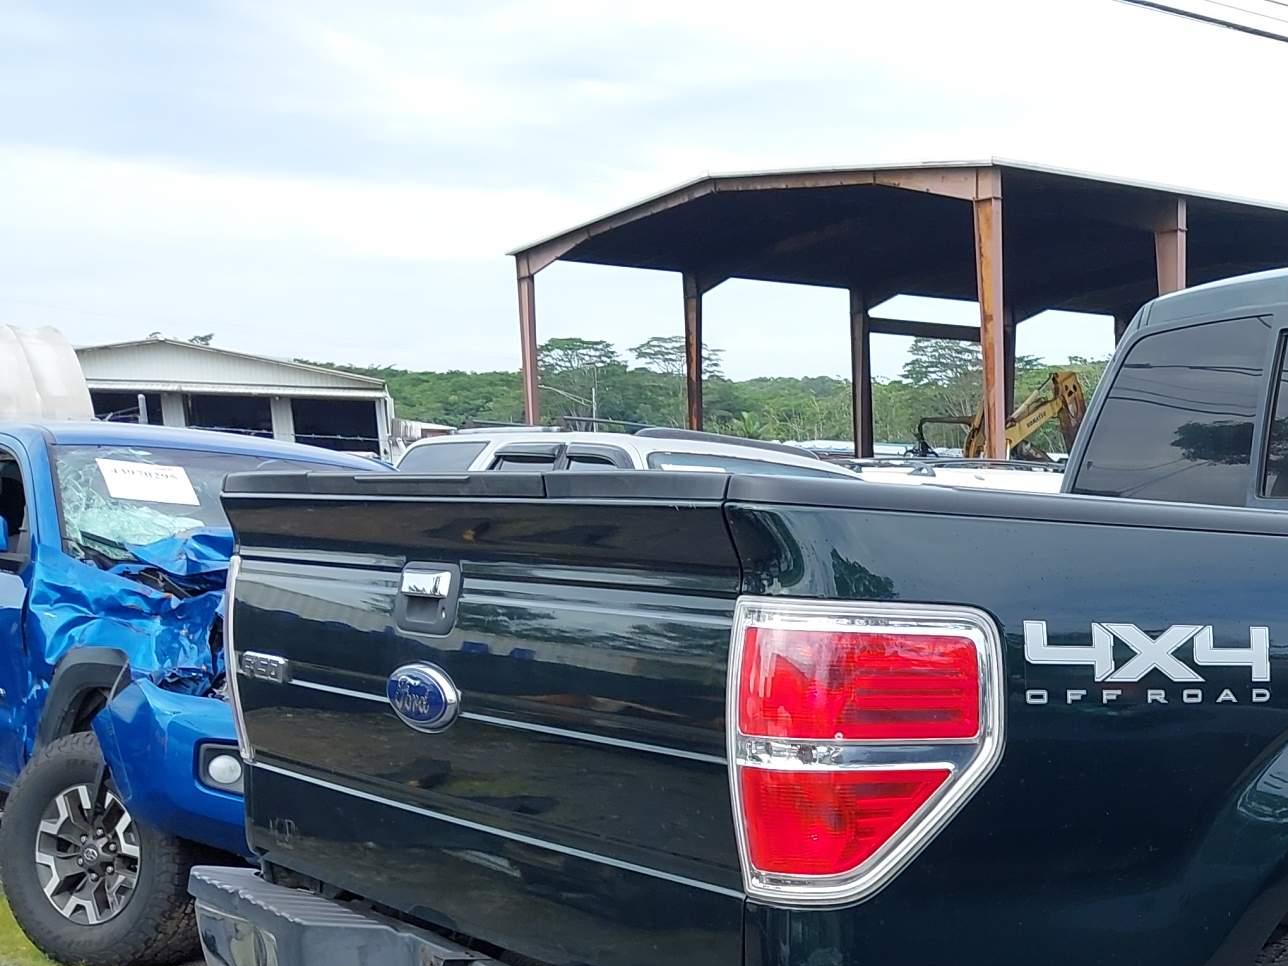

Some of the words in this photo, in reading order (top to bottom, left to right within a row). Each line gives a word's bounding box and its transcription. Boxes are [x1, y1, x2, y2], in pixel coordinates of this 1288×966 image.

[1023, 620, 1271, 682] 4X4
[1025, 689, 1123, 704] OFF
[1147, 688, 1272, 704] ROAD
